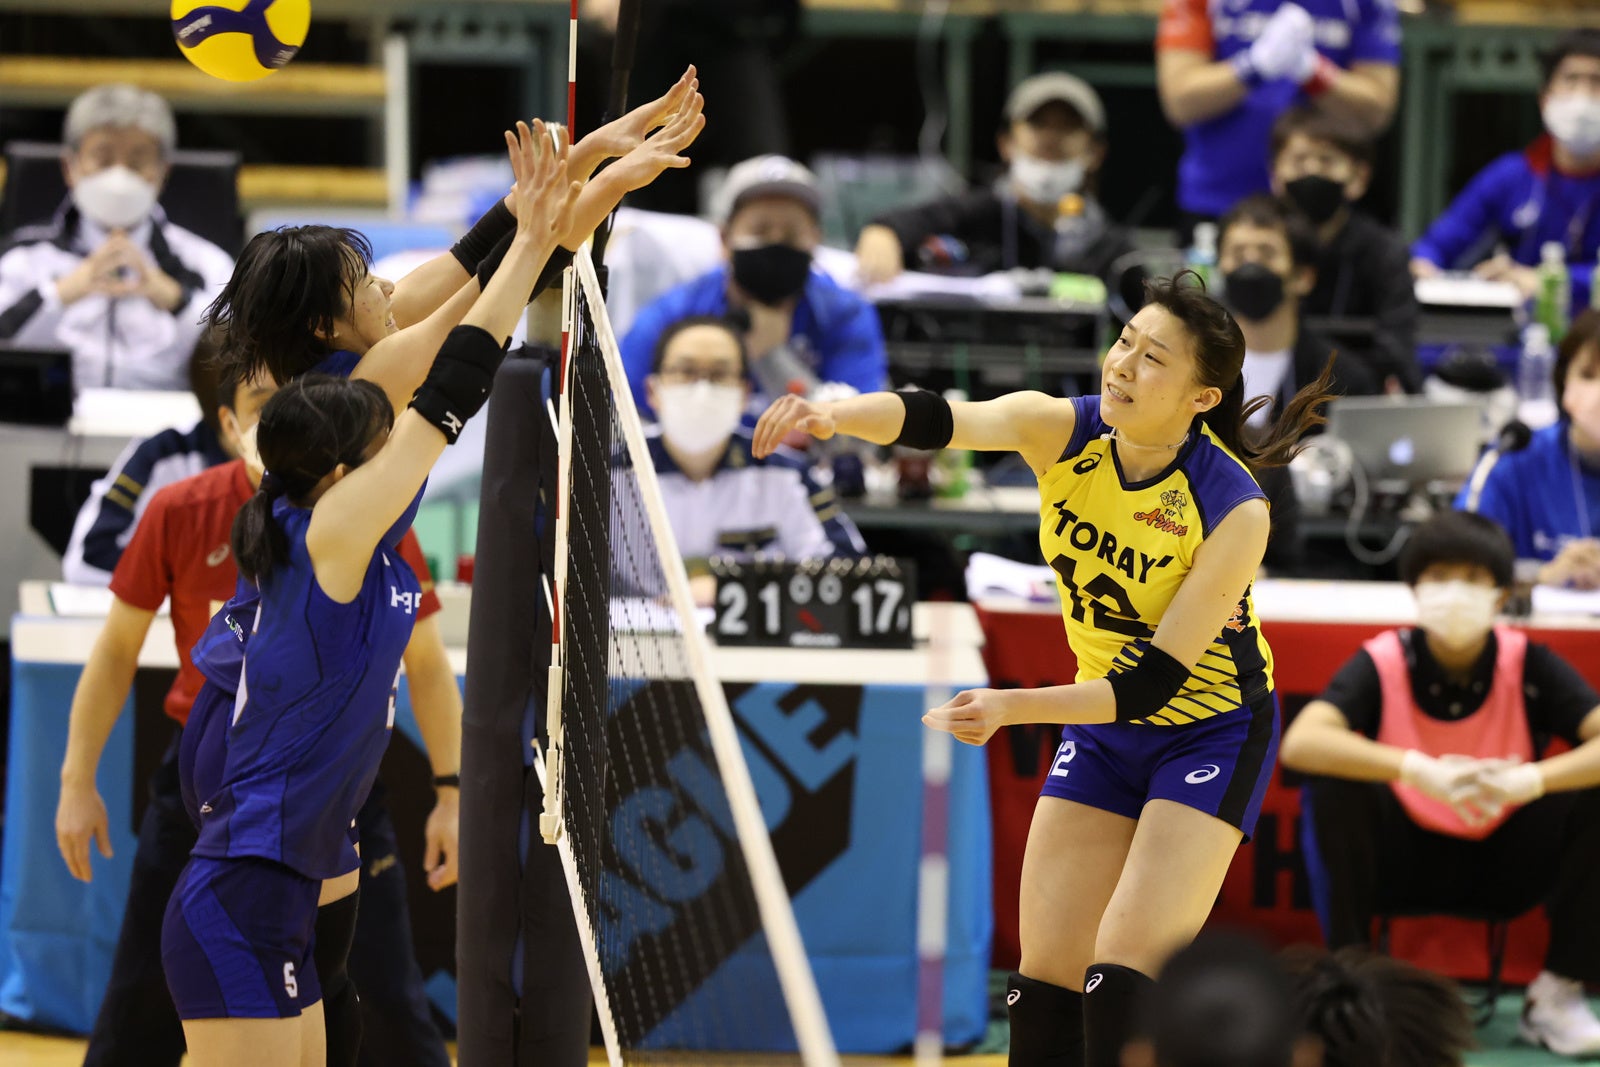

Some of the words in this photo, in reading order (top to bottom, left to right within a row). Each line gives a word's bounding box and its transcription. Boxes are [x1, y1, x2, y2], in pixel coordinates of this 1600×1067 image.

[852, 579, 905, 636] 17
[1050, 553, 1155, 638] 12
[283, 961, 298, 998] 5
